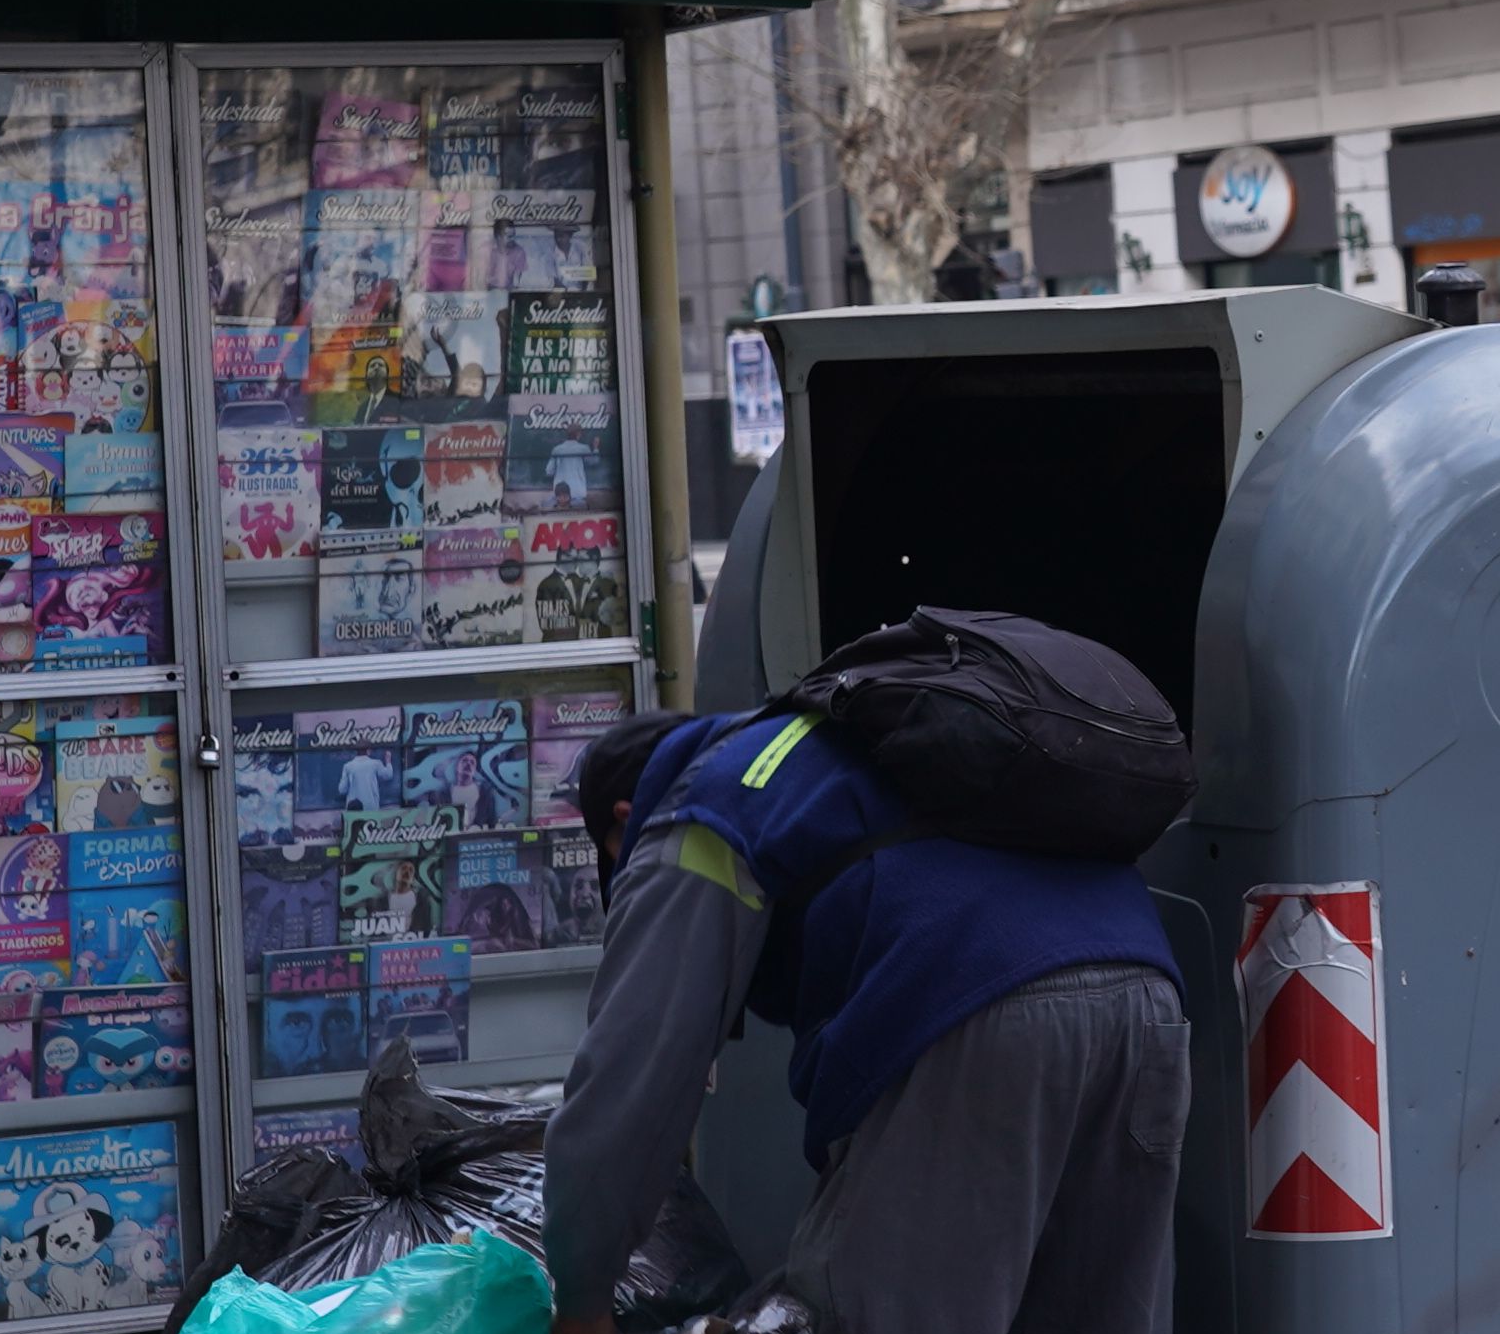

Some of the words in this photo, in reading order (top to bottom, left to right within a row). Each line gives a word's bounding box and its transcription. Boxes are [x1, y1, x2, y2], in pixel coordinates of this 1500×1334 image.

[444, 138, 472, 154] LAS
[441, 156, 465, 174] YA
[467, 155, 490, 173] NO
[1219, 162, 1273, 212] Soy
[31, 193, 147, 244] Granja
[317, 196, 410, 222] Sudestada
[485, 195, 582, 223] Sudestada
[524, 298, 608, 325] Sudestada
[525, 339, 553, 358] LAS
[558, 337, 608, 358] PIBAS
[520, 359, 543, 376] YA
[546, 359, 570, 375] NO
[523, 404, 610, 431] Sudestada
[237, 447, 298, 475] 365
[238, 477, 299, 493] ILUSTRADAS
[331, 466, 364, 485] Lejos
[331, 481, 349, 497] del
[352, 483, 380, 496] mar
[53, 533, 104, 559] SUPER
[438, 536, 512, 553] Palestina
[530, 518, 620, 554] AMOR
[537, 599, 570, 619] TRAJES
[309, 717, 401, 749] Sudestada
[417, 709, 511, 739] Sudestada
[87, 736, 147, 756] BARE
[63, 753, 149, 781] BEARS
[357, 818, 448, 847] Sudestada
[84, 834, 182, 857] FORMAS
[459, 859, 490, 871] QUE
[459, 873, 491, 888] NOS
[497, 869, 531, 885] VEN
[350, 915, 406, 937] JUAN
[0, 934, 66, 951] TABLEROS
[380, 946, 441, 962] MAÑANA
[269, 965, 362, 994] Fidel
